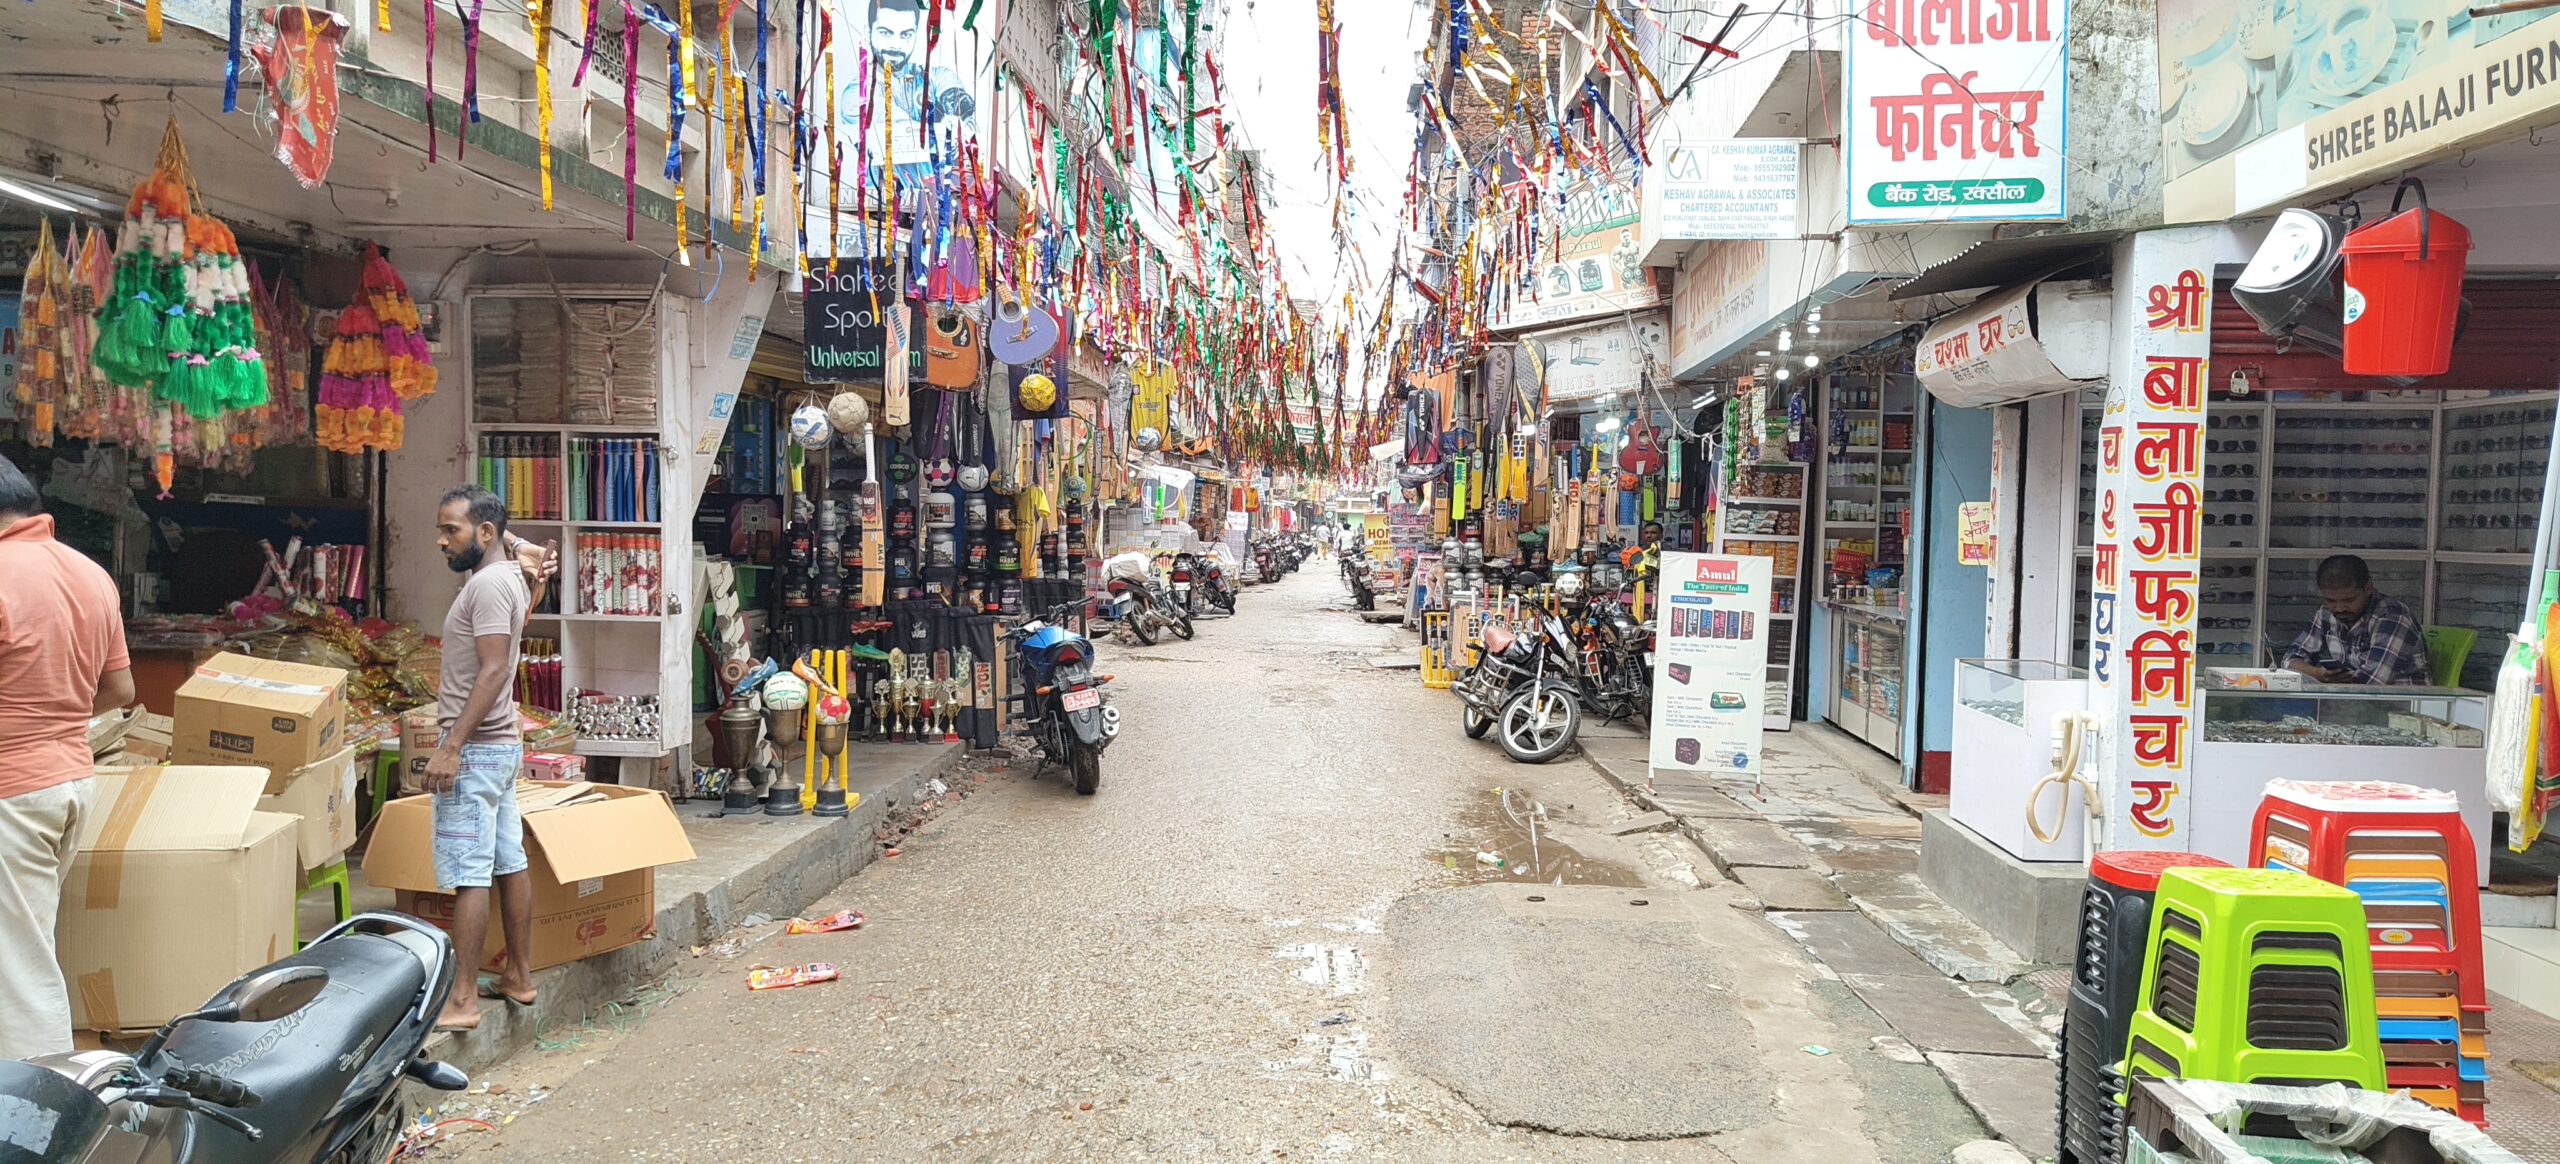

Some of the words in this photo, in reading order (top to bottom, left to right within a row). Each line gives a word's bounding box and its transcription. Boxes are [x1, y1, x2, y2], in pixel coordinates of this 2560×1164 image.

[1870, 70, 2045, 162] फर्निचर
[2308, 113, 2375, 171] SHREE
[2383, 73, 2476, 144] BALAJI
[1722, 145, 1745, 155] KESHAV
[1747, 145, 1768, 155] KUMAR
[1768, 144, 1796, 155] AGRAWAL
[1754, 163, 1796, 172] 9555392902
[1754, 174, 1795, 182] 9431637767
[1664, 189, 1695, 200] KESHAV
[1698, 188, 1736, 200] AGRAWAL
[1738, 189, 1744, 200] &
[1747, 188, 1796, 200] ASSOCIATES
[1884, 183, 1918, 203] बैंक
[1922, 183, 1956, 203] रोड,
[1963, 180, 2027, 201] रक्सौल
[1680, 202, 1723, 213] CHARTERED
[1725, 202, 1779, 213] ACCOUNTANTS
[1630, 288, 1655, 299] COSCO
[2146, 269, 2208, 332] श्री
[1539, 304, 1571, 316] CEAT
[1977, 314, 2007, 355] घर
[810, 344, 880, 369] Universal
[2133, 355, 2207, 562] बालाजी
[877, 543, 885, 565] AK47
[894, 557, 906, 566] MB
[1697, 566, 1736, 581] Amul
[926, 584, 941, 594] MB
[1728, 584, 1747, 592] India
[2125, 569, 2199, 839] फर्निचर
[211, 733, 253, 751] TULIPS
